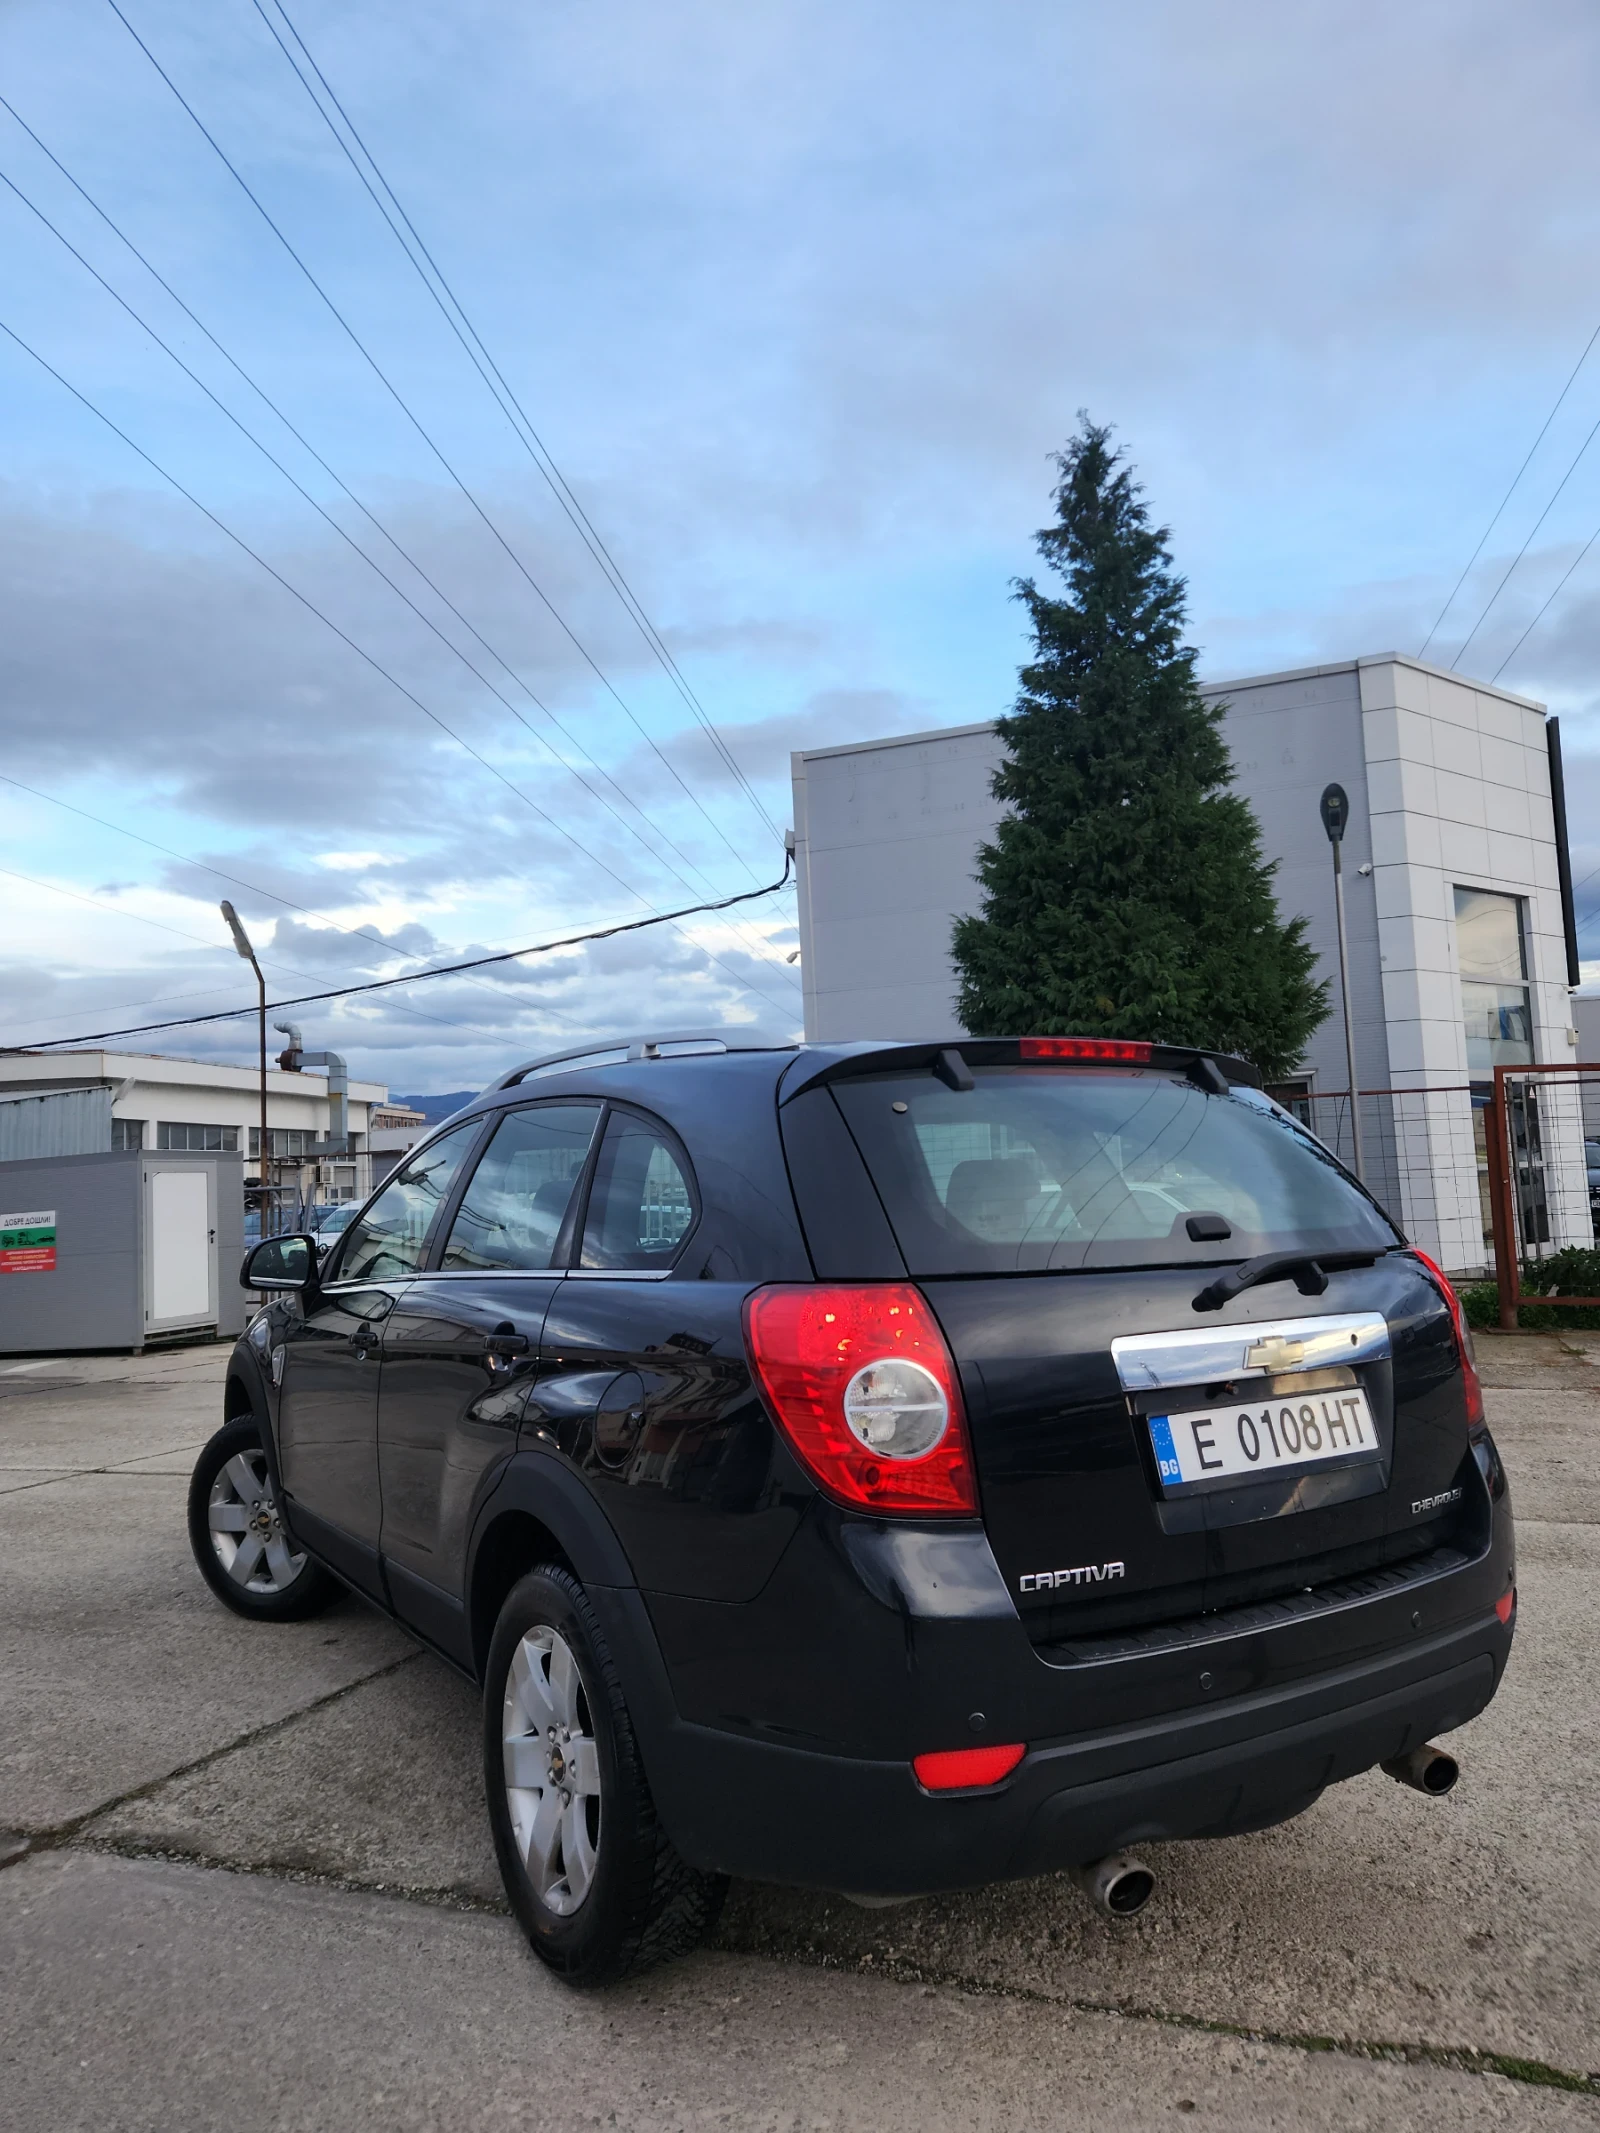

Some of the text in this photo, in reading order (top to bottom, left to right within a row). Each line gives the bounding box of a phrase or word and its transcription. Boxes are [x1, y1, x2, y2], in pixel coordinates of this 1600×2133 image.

[4, 1216, 51, 1227] ДОБРЕ ДОШЛИ!
[1190, 1419, 1223, 1470] E
[1160, 1459, 1178, 1476] BG
[1020, 1561, 1125, 1592] CAPTIVA
